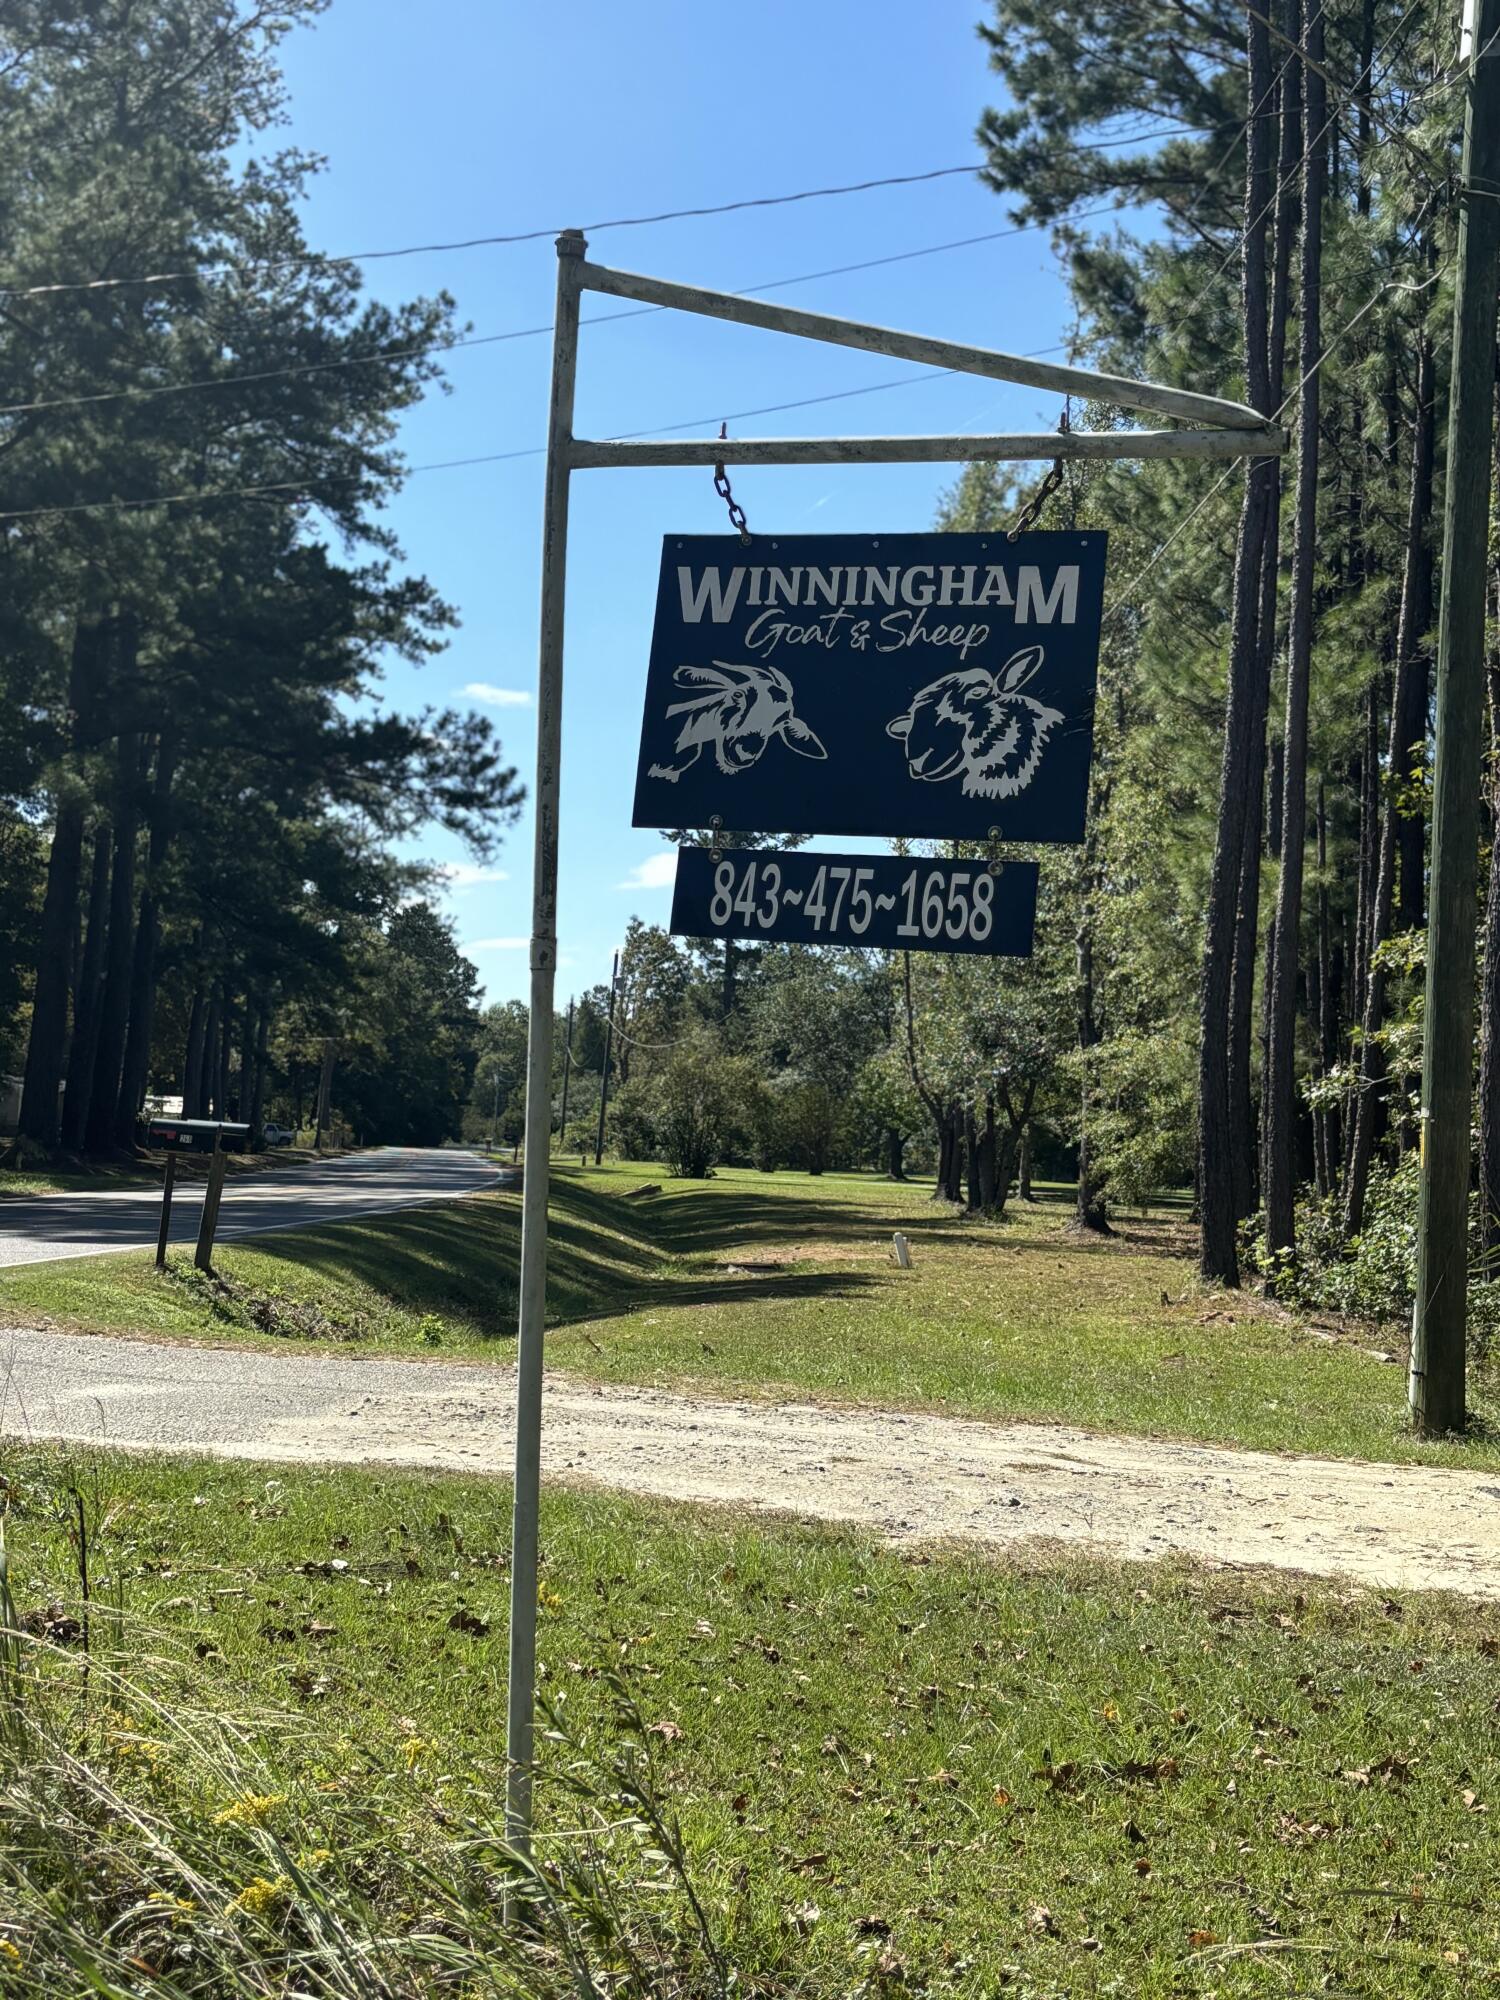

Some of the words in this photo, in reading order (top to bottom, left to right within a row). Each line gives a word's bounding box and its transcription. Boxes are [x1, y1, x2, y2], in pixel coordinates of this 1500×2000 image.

[677, 565, 1080, 624] WINNINGHAM
[745, 607, 854, 658] Goat
[850, 619, 871, 651] &
[876, 607, 990, 660] Sheep
[709, 861, 995, 941] 843~475~1658
